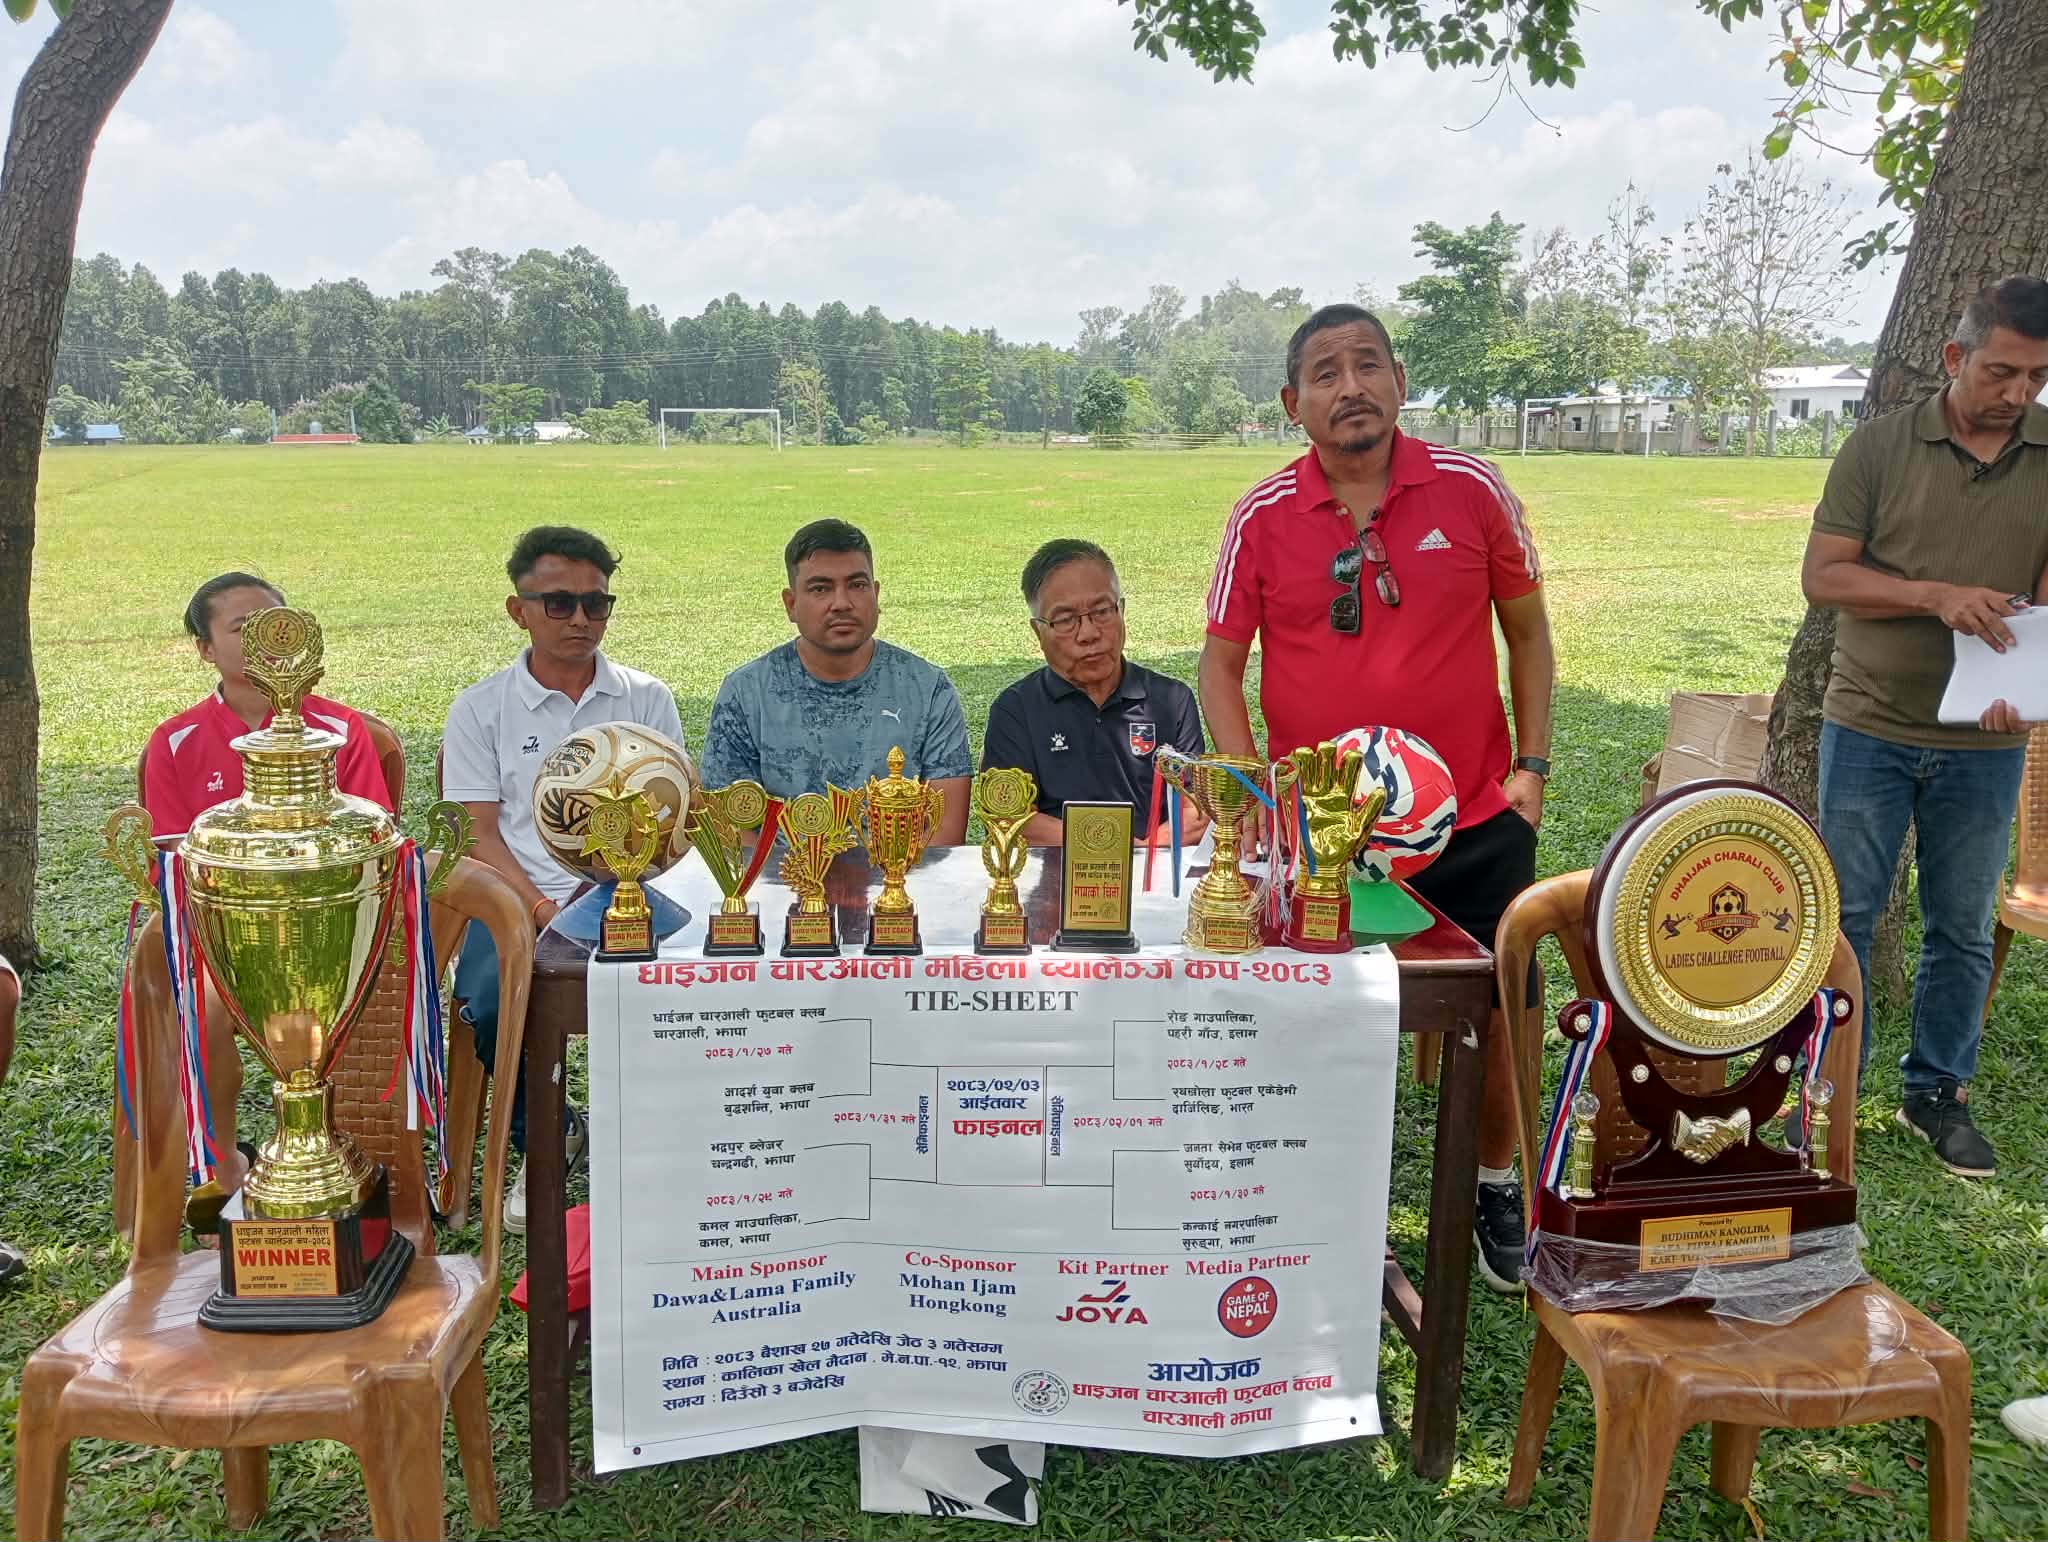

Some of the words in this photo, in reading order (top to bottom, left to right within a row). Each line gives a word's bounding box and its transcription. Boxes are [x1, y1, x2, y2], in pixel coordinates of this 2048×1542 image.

[1670, 857, 1712, 901] DHAIJAN
[1714, 851, 1762, 869] CHARALI
[1763, 866, 1785, 895] CLUB
[1665, 953, 1695, 968] LADIES
[1696, 949, 1744, 967] CHALLENGE
[1745, 945, 1785, 963] FOOTBALL
[638, 960, 759, 988] धाइजन
[769, 955, 915, 982] चारआली
[925, 953, 1028, 981] महिला
[904, 990, 1079, 1011] TIE-SHEET
[700, 1008, 751, 1022] चारआली
[757, 1008, 794, 1023] फुटबल
[1228, 1029, 1258, 1039] इलाम
[777, 1044, 794, 1056] गते
[1233, 1056, 1247, 1068] गते
[947, 1078, 1040, 1093] २०८३/०२/०३
[1229, 1102, 1255, 1113] भारत
[952, 1119, 1044, 1138] फाइनल
[699, 1221, 730, 1232] कमल
[239, 1249, 331, 1266] WINNER
[691, 1265, 743, 1282] Main
[750, 1253, 828, 1277] Sponsor
[905, 1251, 1017, 1273] Co-Sponsor
[1058, 1259, 1089, 1275] Kit
[1095, 1260, 1169, 1276] Partner
[1185, 1259, 1243, 1275] Media
[1248, 1254, 1311, 1272] Partner
[652, 1283, 786, 1309] Dawa&Lama
[792, 1270, 857, 1293] Family
[899, 1273, 966, 1292] Mohan
[972, 1278, 1017, 1298] Ijam
[909, 1294, 1008, 1318] Hongkong
[1226, 1293, 1257, 1306] GAME
[1257, 1291, 1271, 1302] OF
[711, 1300, 802, 1324] Australia
[1056, 1306, 1149, 1325] JOYA
[1226, 1301, 1270, 1320] NEPAL
[663, 1354, 699, 1372] मिति
[714, 1350, 755, 1364] २०८३
[811, 1340, 831, 1352] २७
[896, 1333, 923, 1348] जेठ
[928, 1339, 938, 1350] ३
[662, 1374, 706, 1391] स्थान
[721, 1364, 785, 1382] कालिका
[789, 1359, 821, 1373] खेल
[966, 1359, 1009, 1372] झापा
[1148, 1357, 1262, 1382] आयोजक
[662, 1394, 706, 1411] समय
[772, 1384, 783, 1395] ३
[1072, 1383, 1140, 1401] धाइजन
[1146, 1386, 1228, 1406] चारआली
[1234, 1379, 1288, 1404] फुटबल
[1293, 1374, 1335, 1392] क्लब
[1143, 1409, 1225, 1429] चारआली
[1231, 1407, 1273, 1426] झापा
